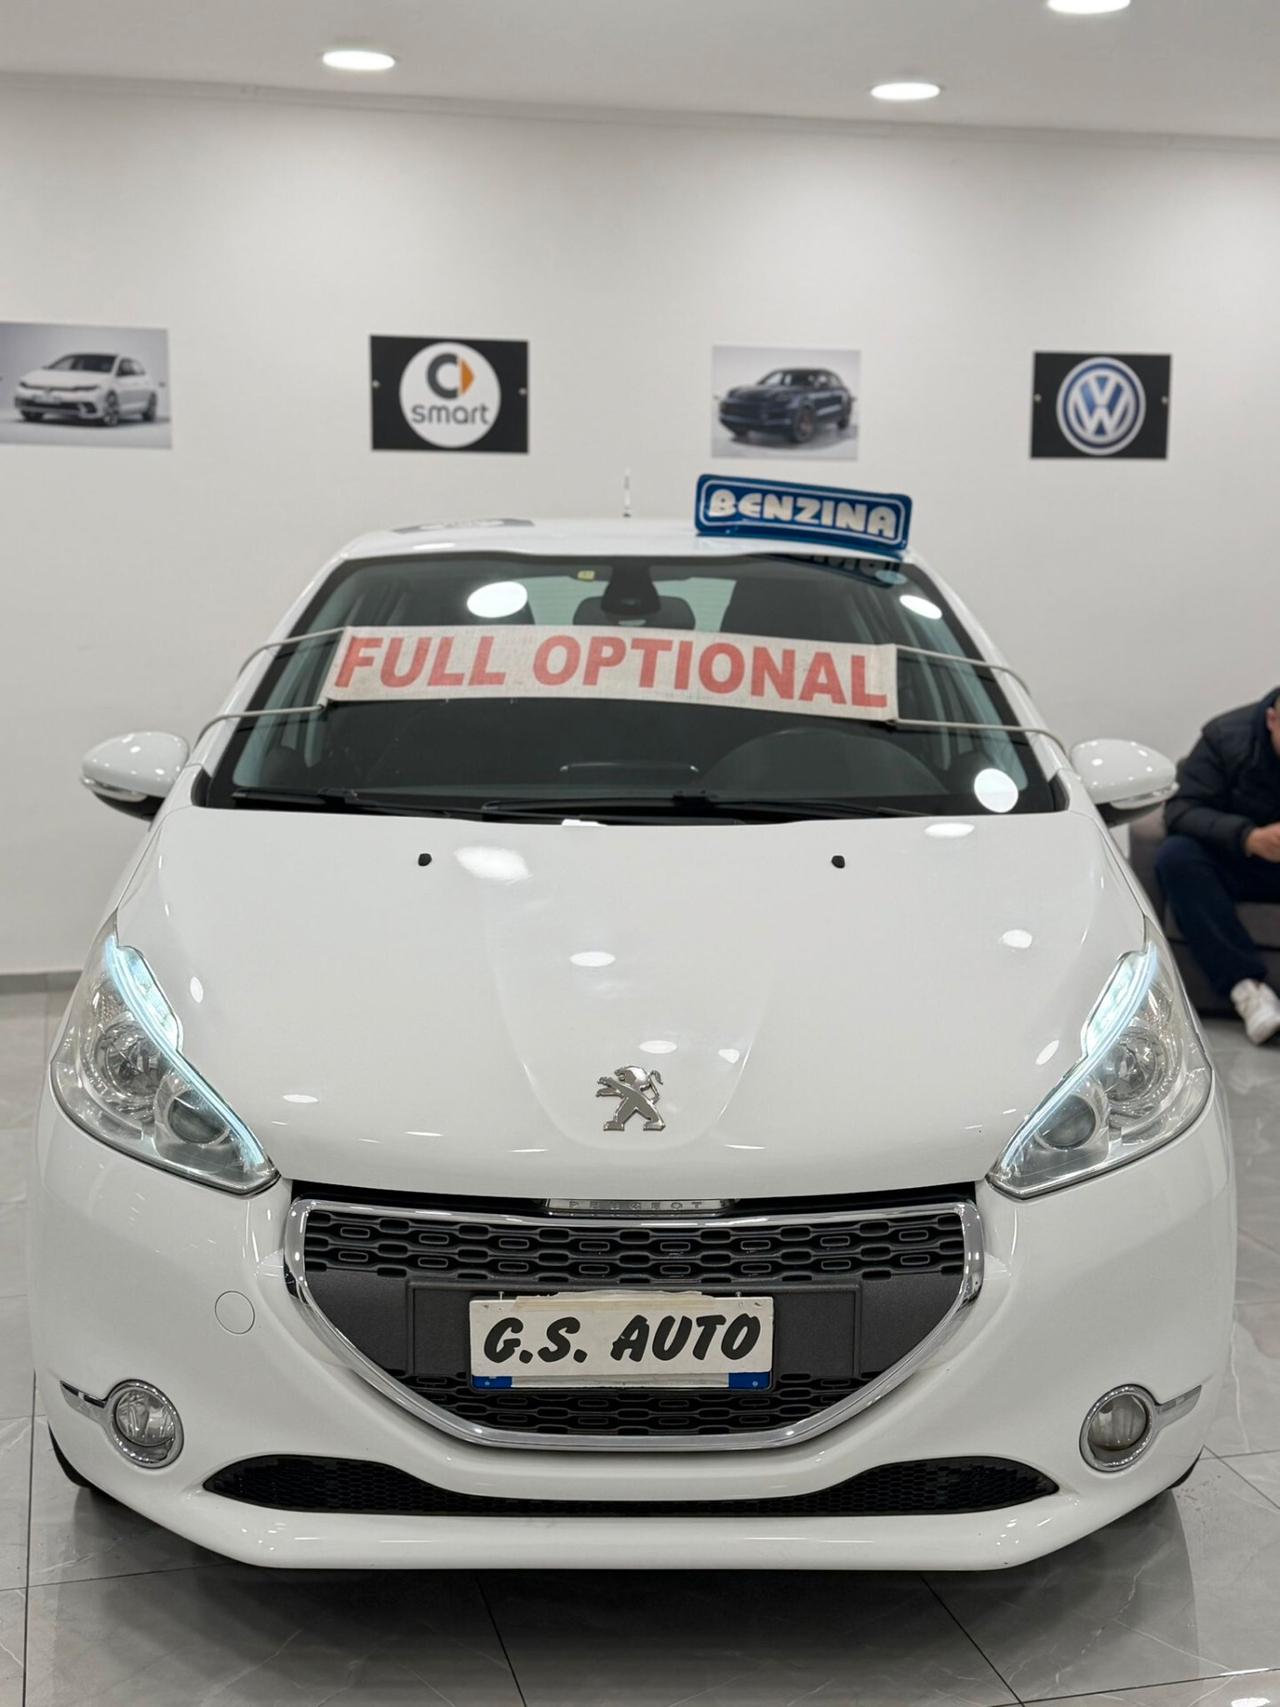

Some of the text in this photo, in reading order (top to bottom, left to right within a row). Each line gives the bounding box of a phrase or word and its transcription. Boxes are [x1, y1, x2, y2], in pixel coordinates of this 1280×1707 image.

[411, 404, 490, 425] smart
[707, 488, 897, 539] BENZINA
[335, 635, 888, 708] FULL OPTIONAL
[484, 1313, 761, 1364] G.S. AUTO
